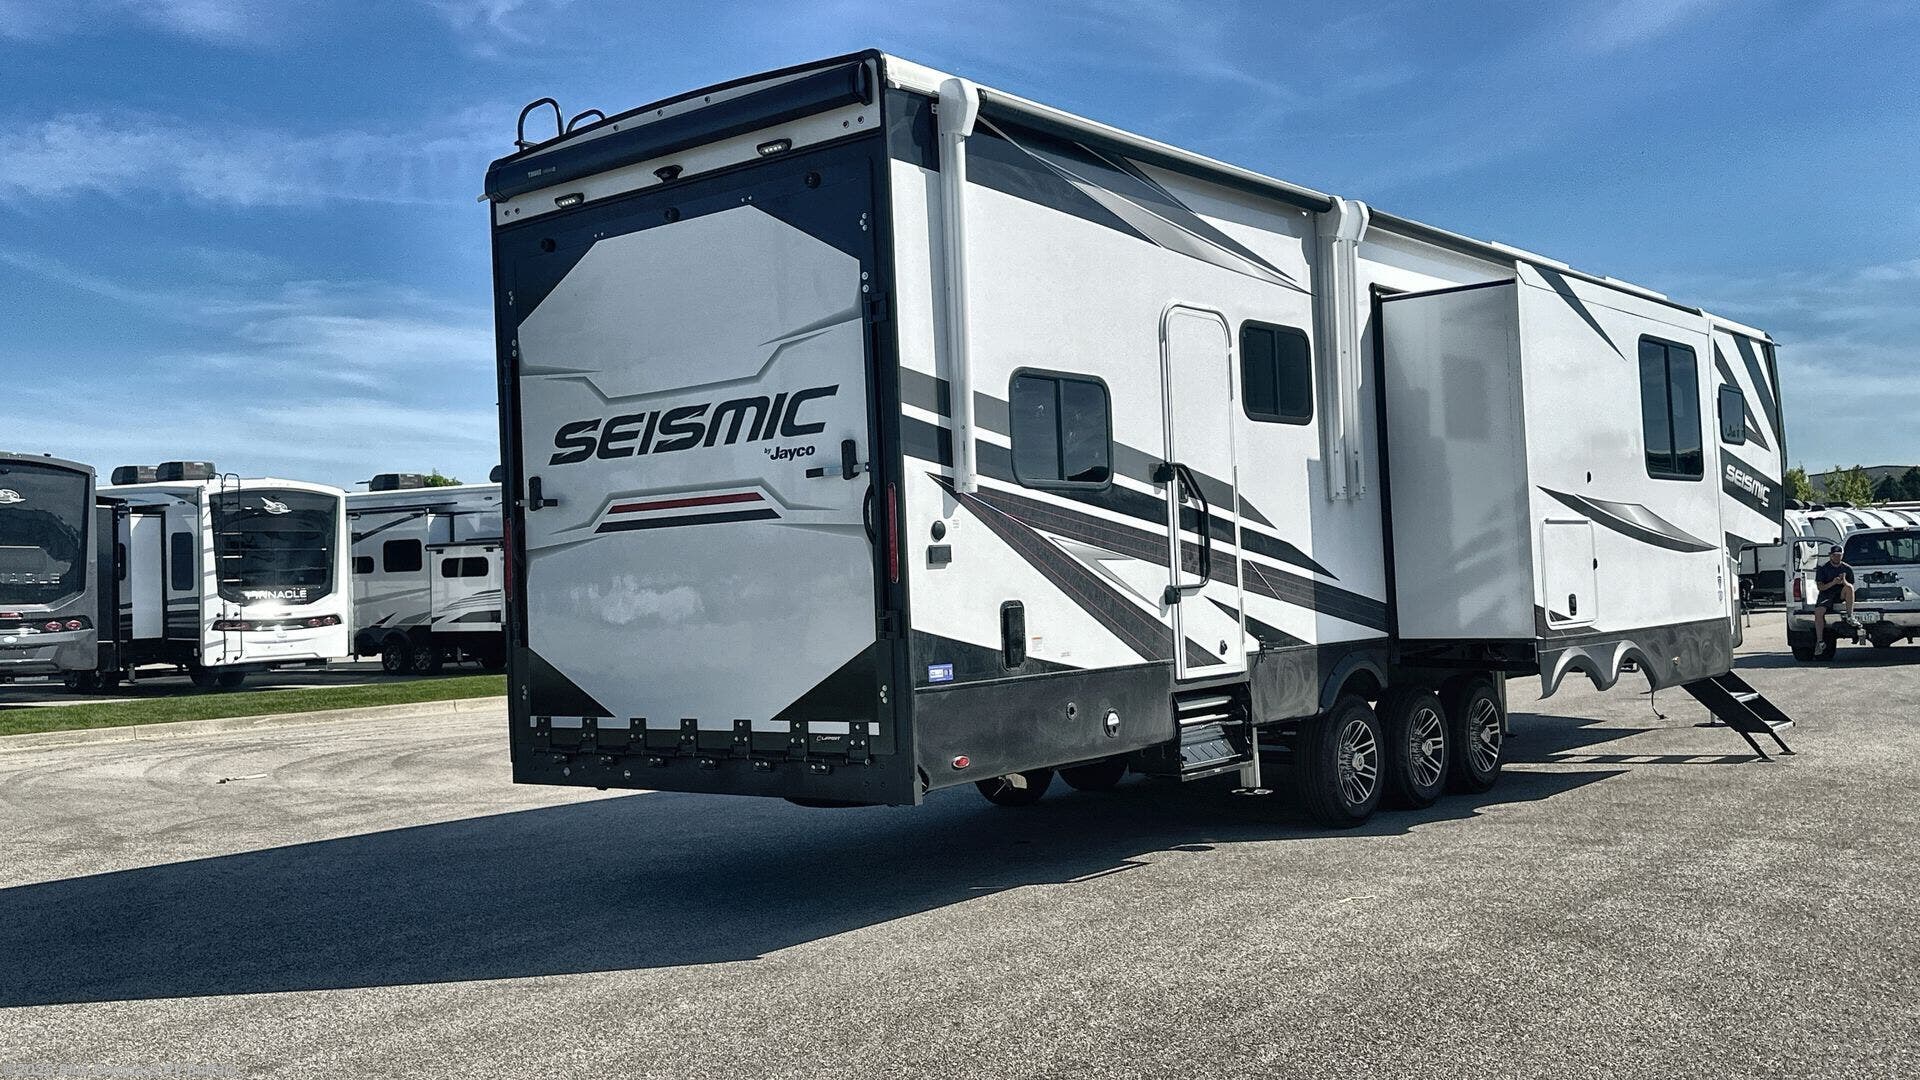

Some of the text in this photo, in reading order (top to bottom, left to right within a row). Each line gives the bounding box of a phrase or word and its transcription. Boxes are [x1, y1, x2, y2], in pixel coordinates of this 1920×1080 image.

[548, 384, 839, 466] SEISMIC
[769, 445, 816, 462] Jayco
[1725, 464, 1771, 503] SEISMIC
